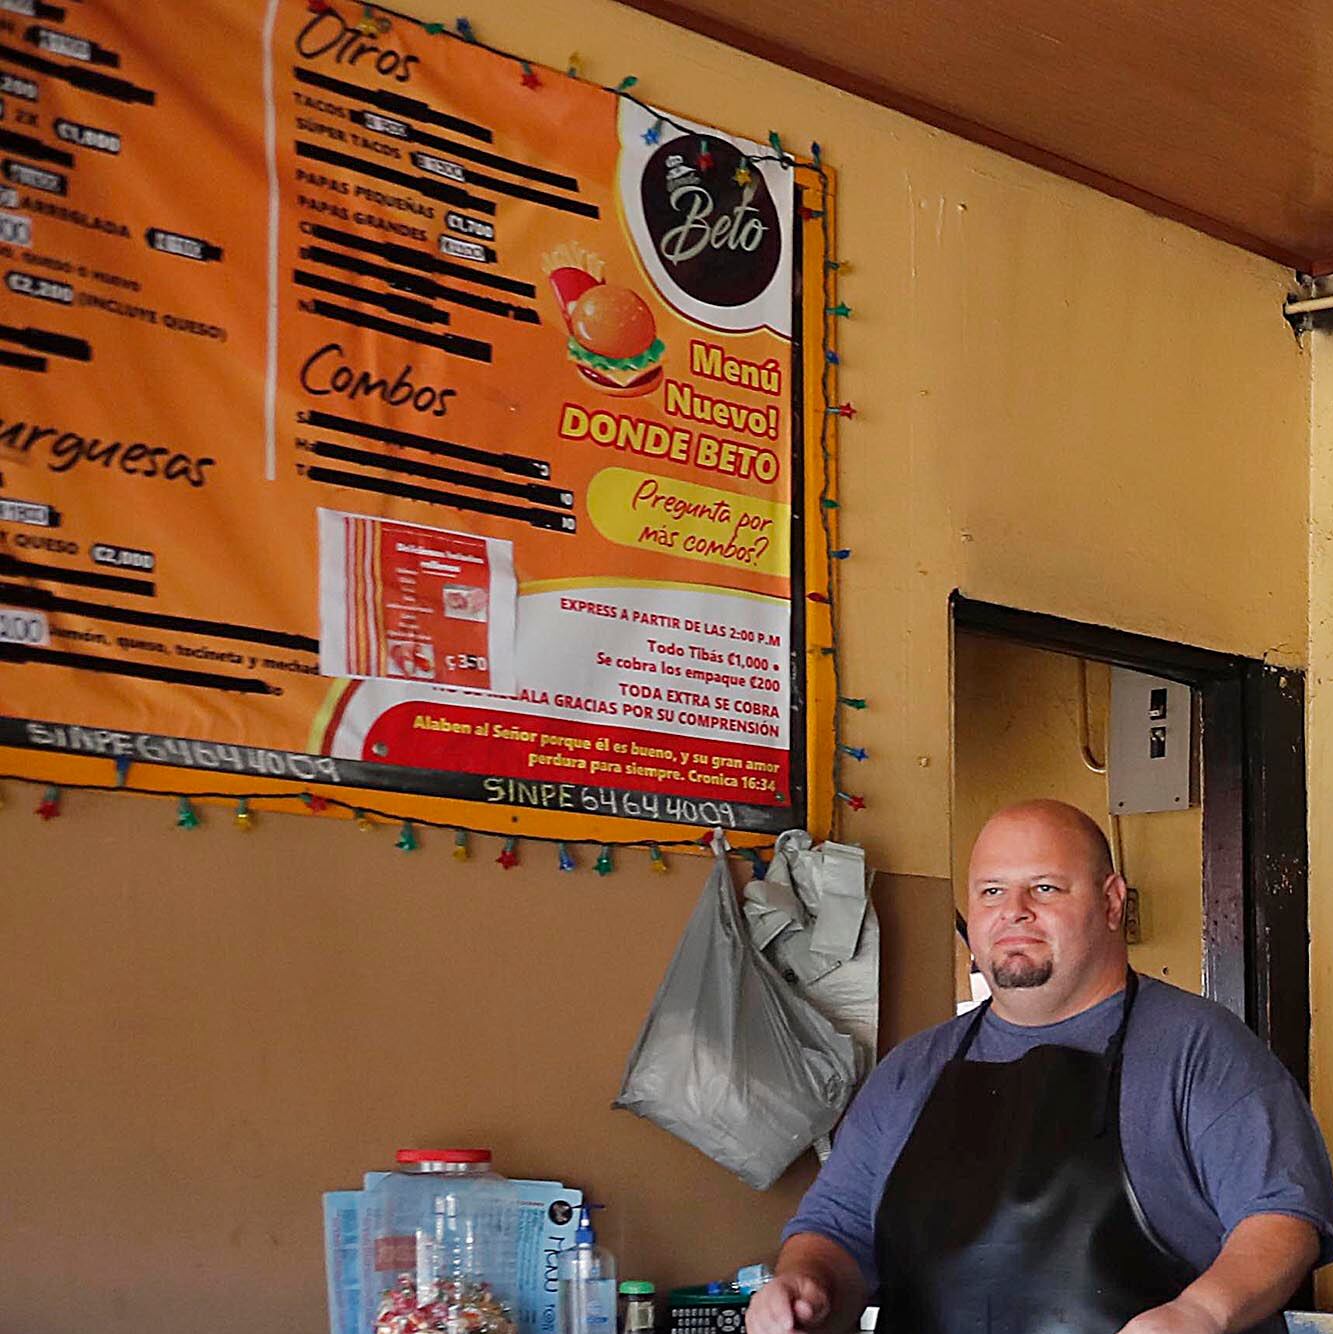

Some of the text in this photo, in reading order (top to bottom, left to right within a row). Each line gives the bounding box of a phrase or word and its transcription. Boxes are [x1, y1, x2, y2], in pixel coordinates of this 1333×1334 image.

[296, 8, 420, 82] Otros
[294, 91, 345, 118] TACOS
[350, 134, 401, 159] TACOS
[296, 168, 349, 195] PAPAS
[354, 186, 435, 219] PEQUEÑAS
[297, 194, 428, 241] PAPAS GRANDES
[661, 182, 769, 266] Beto
[301, 343, 457, 417] Combos
[691, 340, 781, 395] Menú
[665, 380, 779, 439] Nuevo!
[559, 403, 780, 483] DONDE BETO
[632, 479, 774, 541] Pregunta por
[638, 525, 769, 567] más combos?
[560, 598, 617, 620] EXPRESS
[620, 609, 630, 622] A
[633, 611, 681, 630] PARTIR
[684, 620, 701, 633] DE
[704, 623, 727, 638] LAS
[730, 627, 756, 643] 2:00
[248, 656, 258, 669] y
[597, 652, 612, 666] Se
[616, 654, 658, 674] cobra
[661, 660, 682, 677] los
[686, 667, 747, 689] empaque
[647, 639, 685, 657] Todo
[689, 646, 724, 664] Tibás
[554, 694, 619, 716] GRACIAS
[623, 703, 653, 721] POR
[657, 708, 675, 723] SU
[679, 711, 781, 738] COMPRENSIÓN
[619, 683, 780, 719] TODA EXTRA SE COBRA
[26, 722, 136, 758] SINPE
[413, 713, 781, 775] Alaben al Señor porque él es bueno, y su gran amor
[483, 777, 576, 808] SINPE
[528, 752, 777, 793] perdura para siempre. Cronica 16:34
